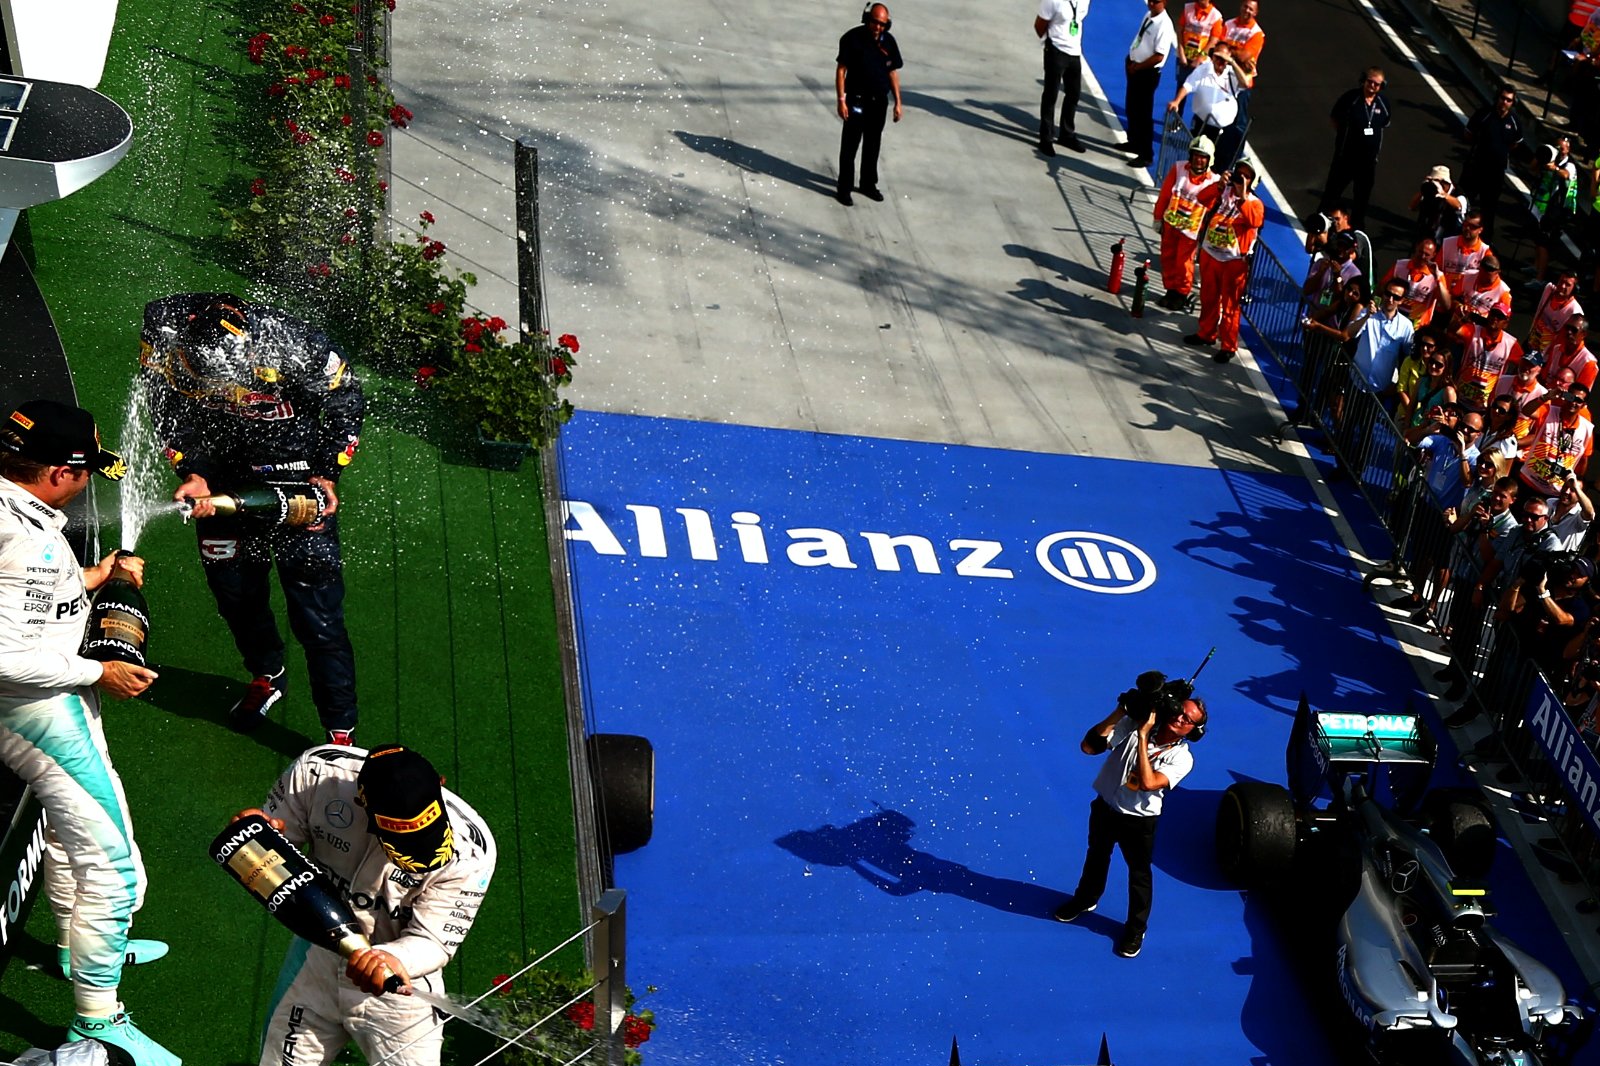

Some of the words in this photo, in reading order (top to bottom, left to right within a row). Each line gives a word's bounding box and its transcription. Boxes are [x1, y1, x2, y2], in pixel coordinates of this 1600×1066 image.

[275, 461, 310, 471] DANIEL
[274, 487, 288, 526] ANDON
[563, 501, 1014, 579] Allianz
[1318, 713, 1416, 731] PETRONAS
[326, 833, 351, 853] UBS
